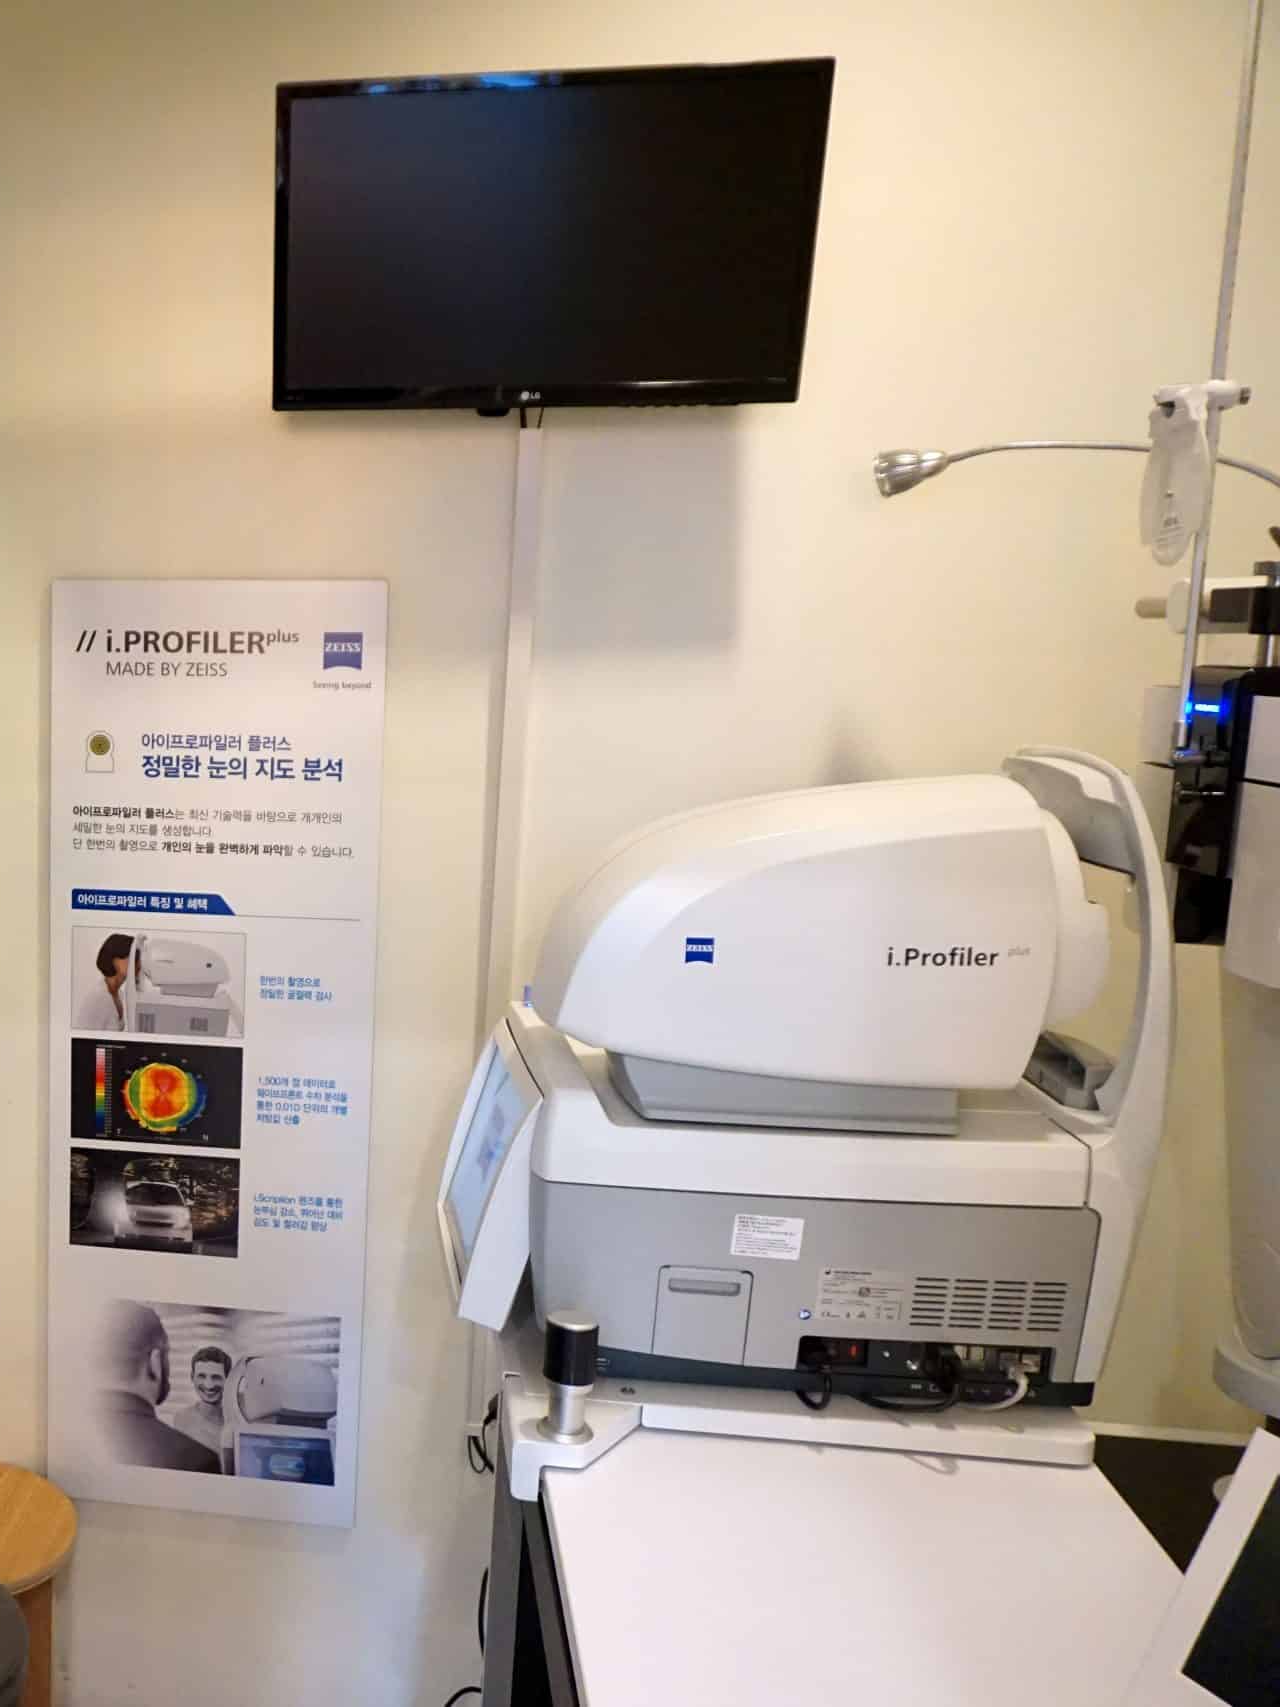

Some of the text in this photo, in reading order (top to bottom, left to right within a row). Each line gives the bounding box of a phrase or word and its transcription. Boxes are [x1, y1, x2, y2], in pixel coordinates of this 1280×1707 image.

[325, 642, 361, 652] ZEISS
[106, 661, 228, 677] MADE BY ZEISS
[141, 733, 292, 751] 아이프로파일러 플러스
[141, 755, 344, 782] 정밀한 눈의 지도 분석
[72, 805, 141, 818] 아이프로파일러
[145, 807, 185, 820] 플러스는
[256, 810, 297, 823] 바탕으로
[106, 823, 125, 834] 눈의
[129, 823, 158, 836] 지도를
[161, 841, 192, 853] 개인의
[195, 842, 215, 854] 눈을
[219, 842, 259, 856] 완벽하게
[77, 893, 147, 908] 아이프로파일러
[687, 944, 713, 952] ZEISS
[887, 946, 1000, 967] i.Profiler
